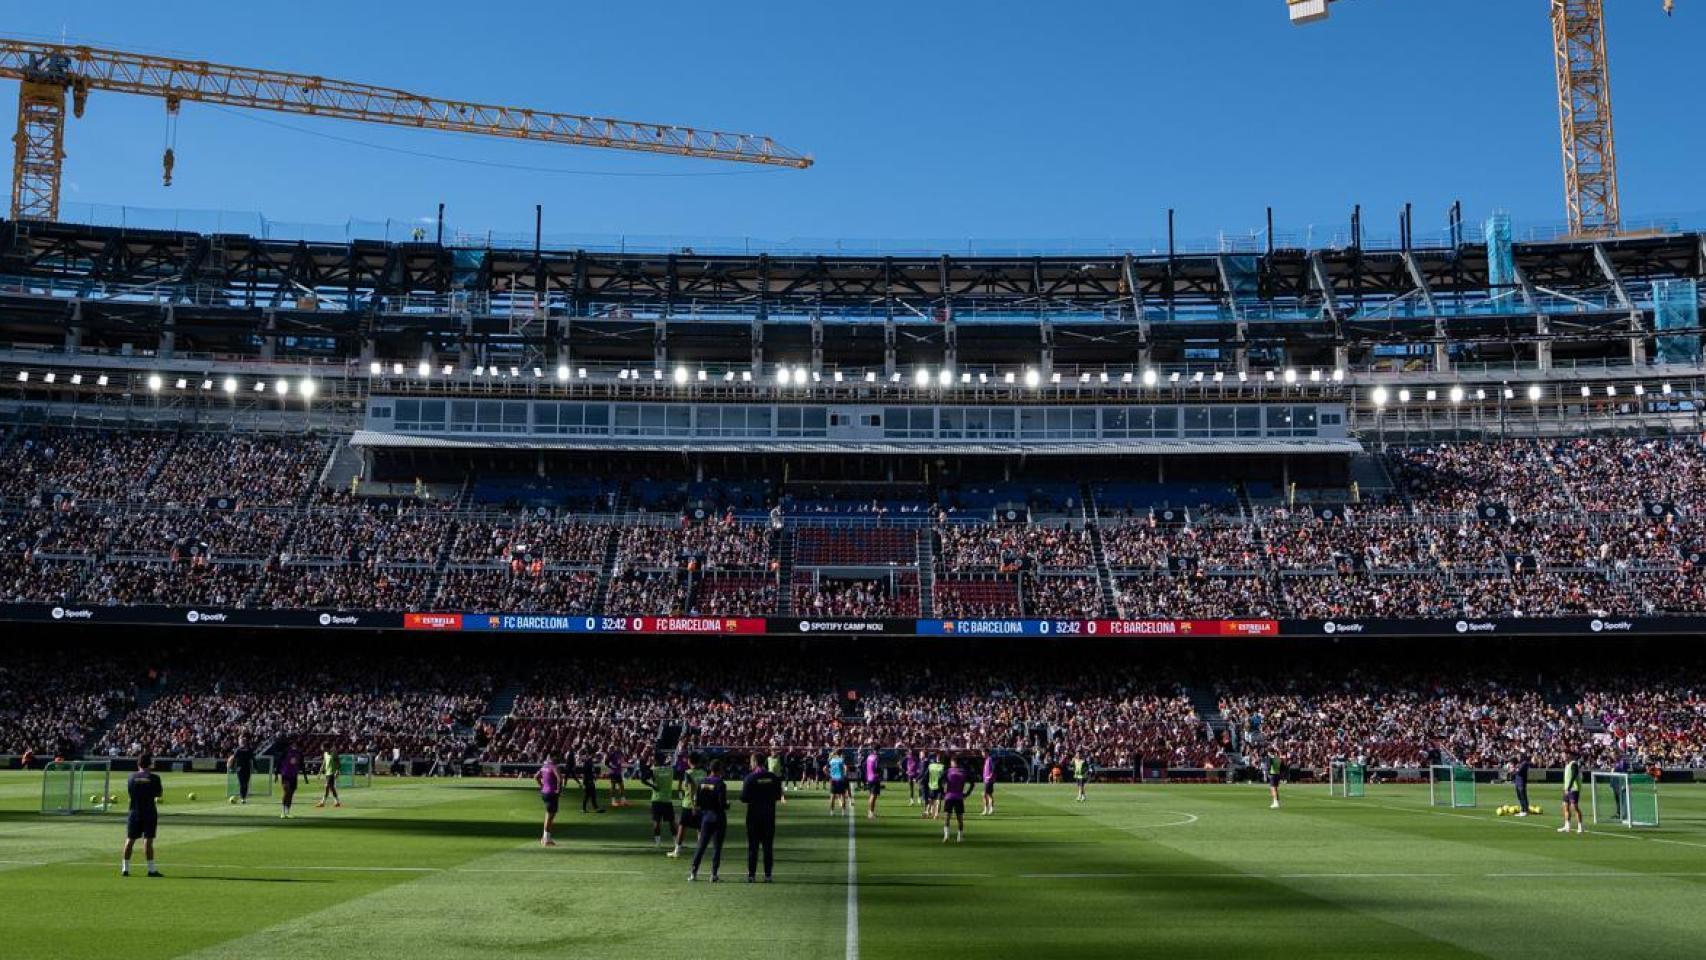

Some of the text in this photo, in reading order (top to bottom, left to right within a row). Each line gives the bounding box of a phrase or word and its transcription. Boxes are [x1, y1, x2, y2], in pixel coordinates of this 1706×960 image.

[65, 610, 93, 618] Spotify
[200, 613, 227, 622] Spotify
[332, 616, 358, 624] Spotify
[504, 616, 568, 629] FC BARCELONA
[586, 618, 594, 630] 0
[602, 618, 626, 630] 32:42
[634, 618, 642, 630] 0
[656, 618, 720, 630] FC BARCELONA
[958, 621, 1022, 633] FC BARCELONA
[1040, 621, 1049, 633] 0
[1056, 622, 1080, 633] 32:42
[1088, 622, 1096, 633] 0
[1110, 622, 1176, 633] FC BARCELONA
[1337, 622, 1363, 632] Spotify
[1469, 622, 1496, 631] Spotify
[1604, 622, 1632, 630] Spotify
